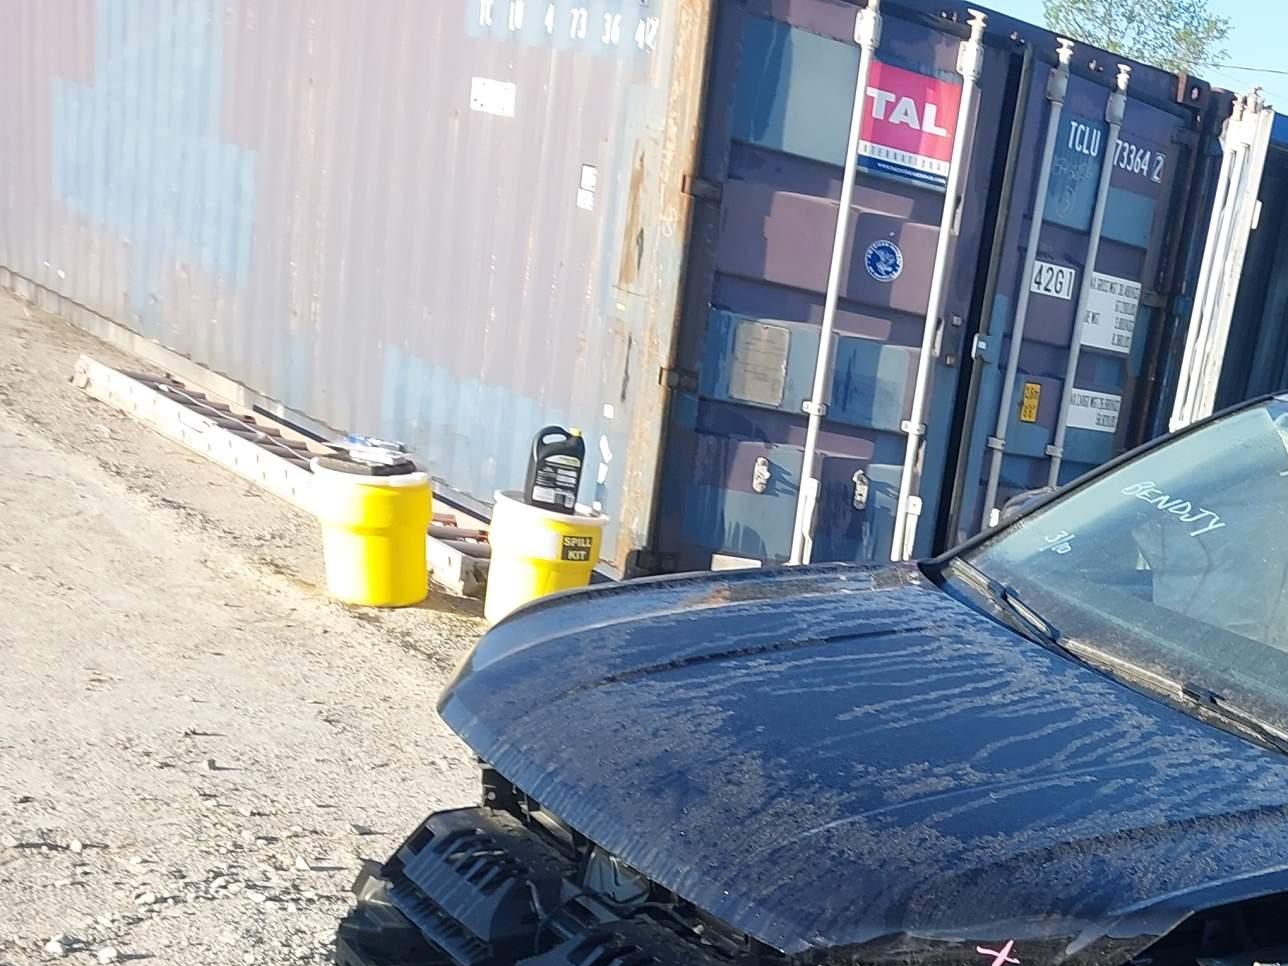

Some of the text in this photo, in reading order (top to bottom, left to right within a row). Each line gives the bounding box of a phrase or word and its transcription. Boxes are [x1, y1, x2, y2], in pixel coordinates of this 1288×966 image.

[866, 86, 948, 137] TAL
[1068, 120, 1101, 157] TCLU
[564, 537, 592, 548] SPILL
[567, 550, 587, 561] KIT
